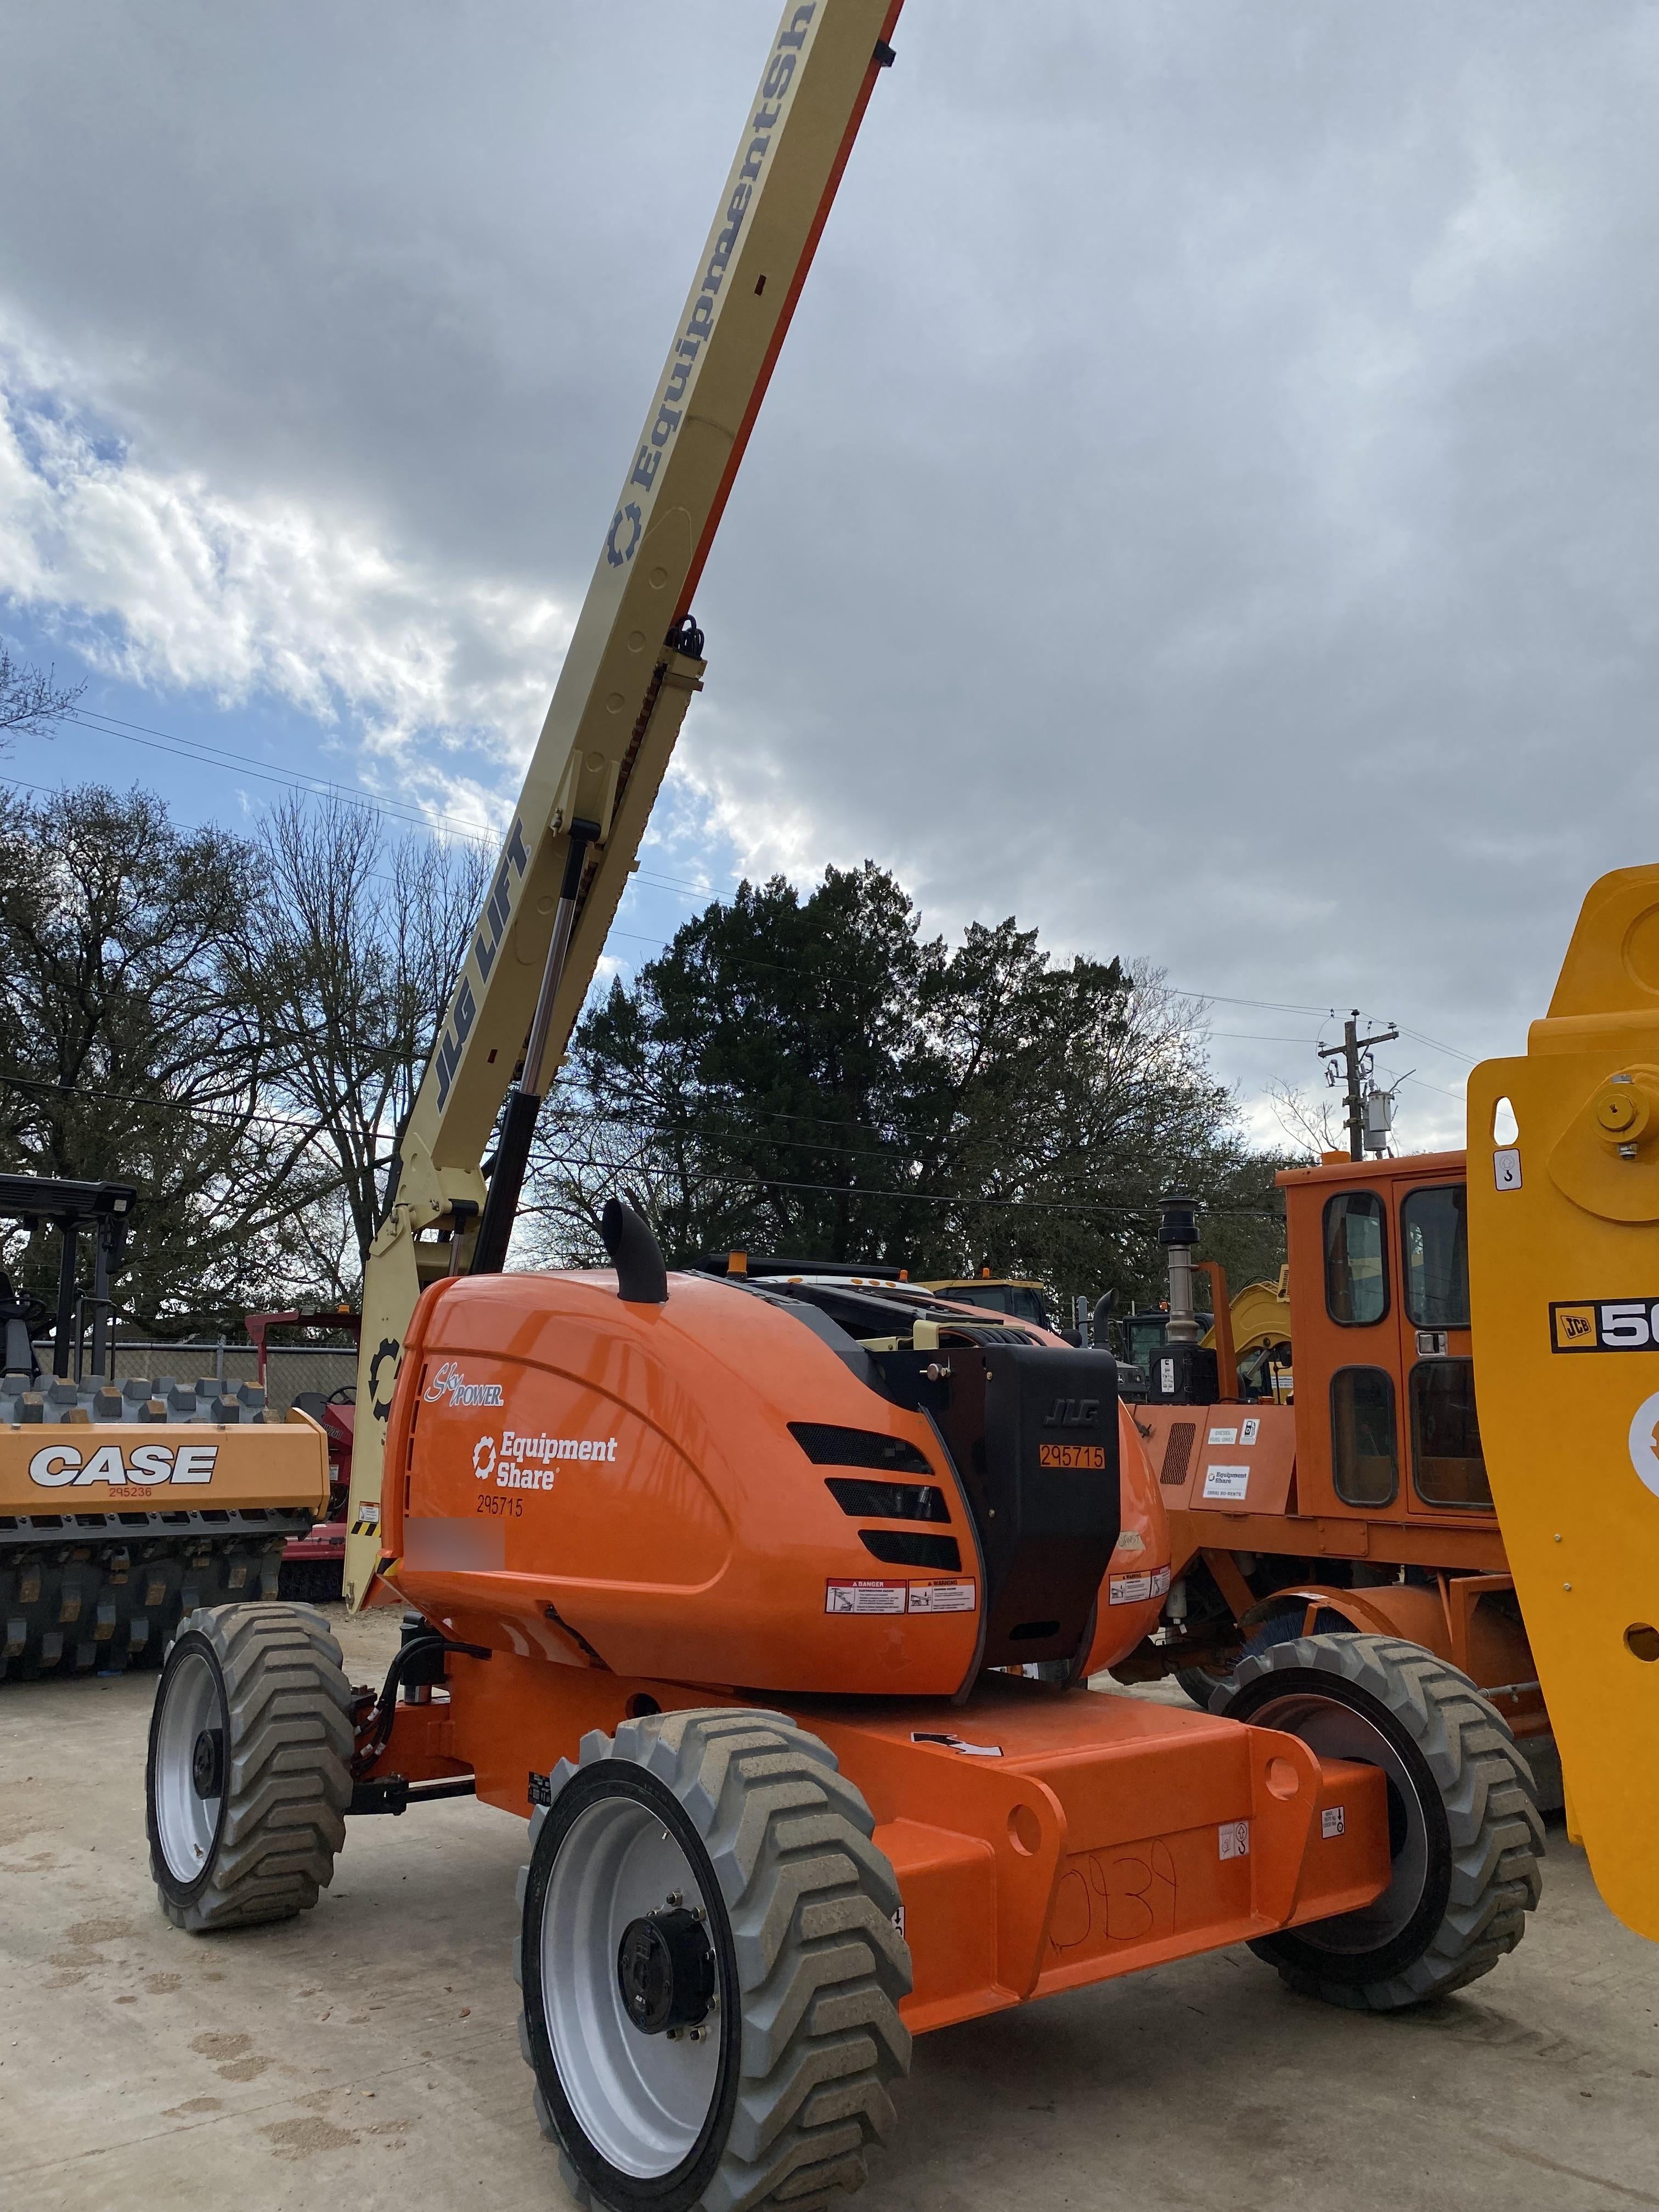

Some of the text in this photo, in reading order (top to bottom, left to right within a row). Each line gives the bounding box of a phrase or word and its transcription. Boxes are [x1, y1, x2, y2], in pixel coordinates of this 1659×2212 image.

[435, 974, 477, 1114] JLG
[1565, 1317, 1589, 1336] JCB
[1601, 1303, 1659, 1346] 5
[1043, 1398, 1100, 1427] JLG
[500, 1431, 618, 1464] Equipment
[1041, 1445, 1103, 1468] 295715
[29, 1445, 219, 1487] CASE
[496, 1462, 555, 1491] Share
[109, 1487, 152, 1497] 295236
[477, 1494, 523, 1517] 295715
